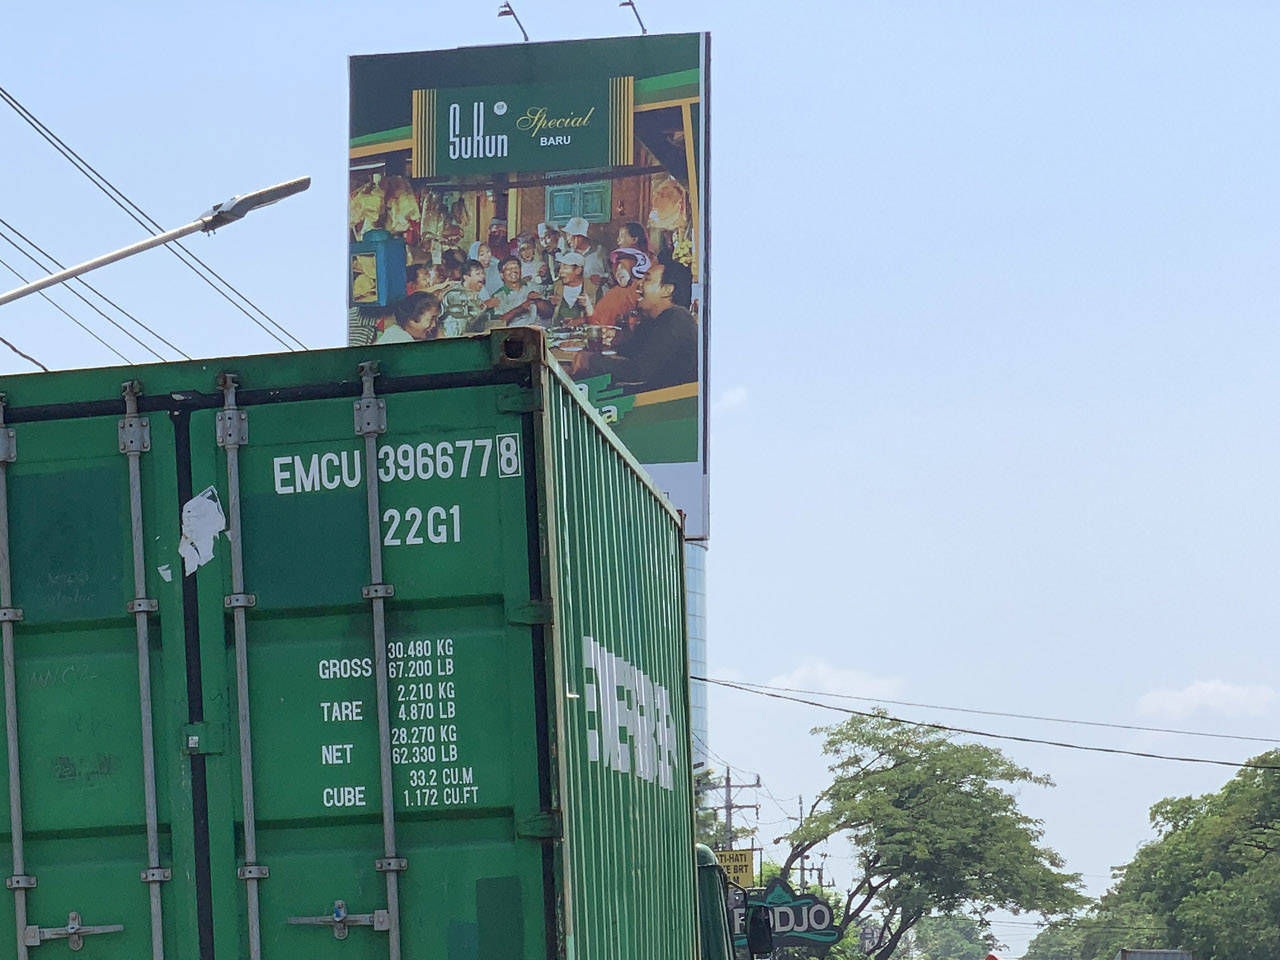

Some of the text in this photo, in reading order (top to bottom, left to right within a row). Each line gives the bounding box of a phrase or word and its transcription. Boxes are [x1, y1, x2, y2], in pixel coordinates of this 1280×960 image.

[516, 106, 595, 138] Special
[539, 135, 571, 147] BARU
[273, 450, 362, 494] EMCU
[383, 504, 461, 546] 22G1
[388, 638, 454, 659] 30.480 KG
[319, 658, 454, 679] GROSS 67.200 LB
[397, 682, 455, 702] 2.210 KG
[320, 701, 456, 722] TARE 4.870 LB
[391, 725, 457, 745] 28.270 KG
[321, 744, 458, 765] NET 62.330 LB
[409, 767, 473, 787] 33.2 CU.M
[323, 786, 479, 808] CUBE 1.172 CU.FT
[733, 864, 749, 874] BRT
